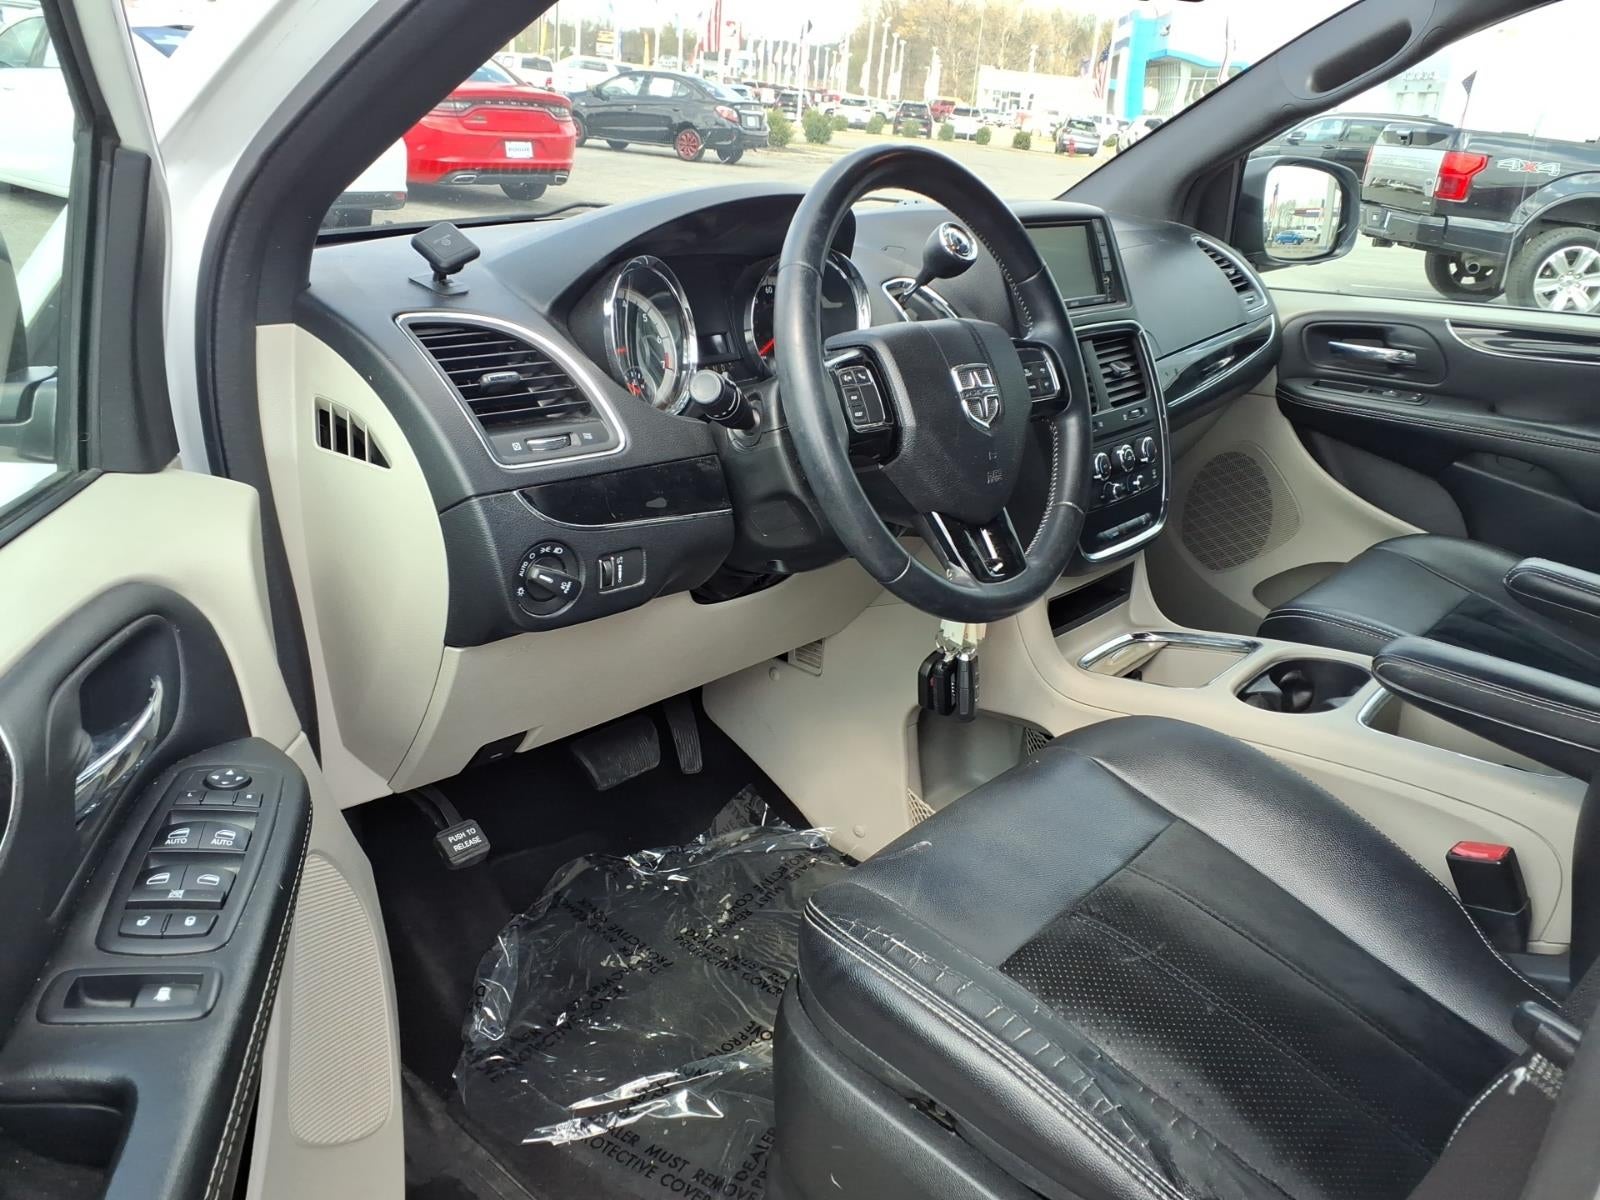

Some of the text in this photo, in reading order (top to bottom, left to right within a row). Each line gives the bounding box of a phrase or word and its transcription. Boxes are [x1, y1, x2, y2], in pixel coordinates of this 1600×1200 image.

[642, 313, 648, 322] 5
[656, 335, 662, 344] 6
[518, 561, 528, 577] AUTO
[165, 838, 188, 846] AUTO
[447, 827, 477, 843] PUSH TO
[452, 835, 482, 852] RELEASE
[643, 1143, 690, 1172] MUST
